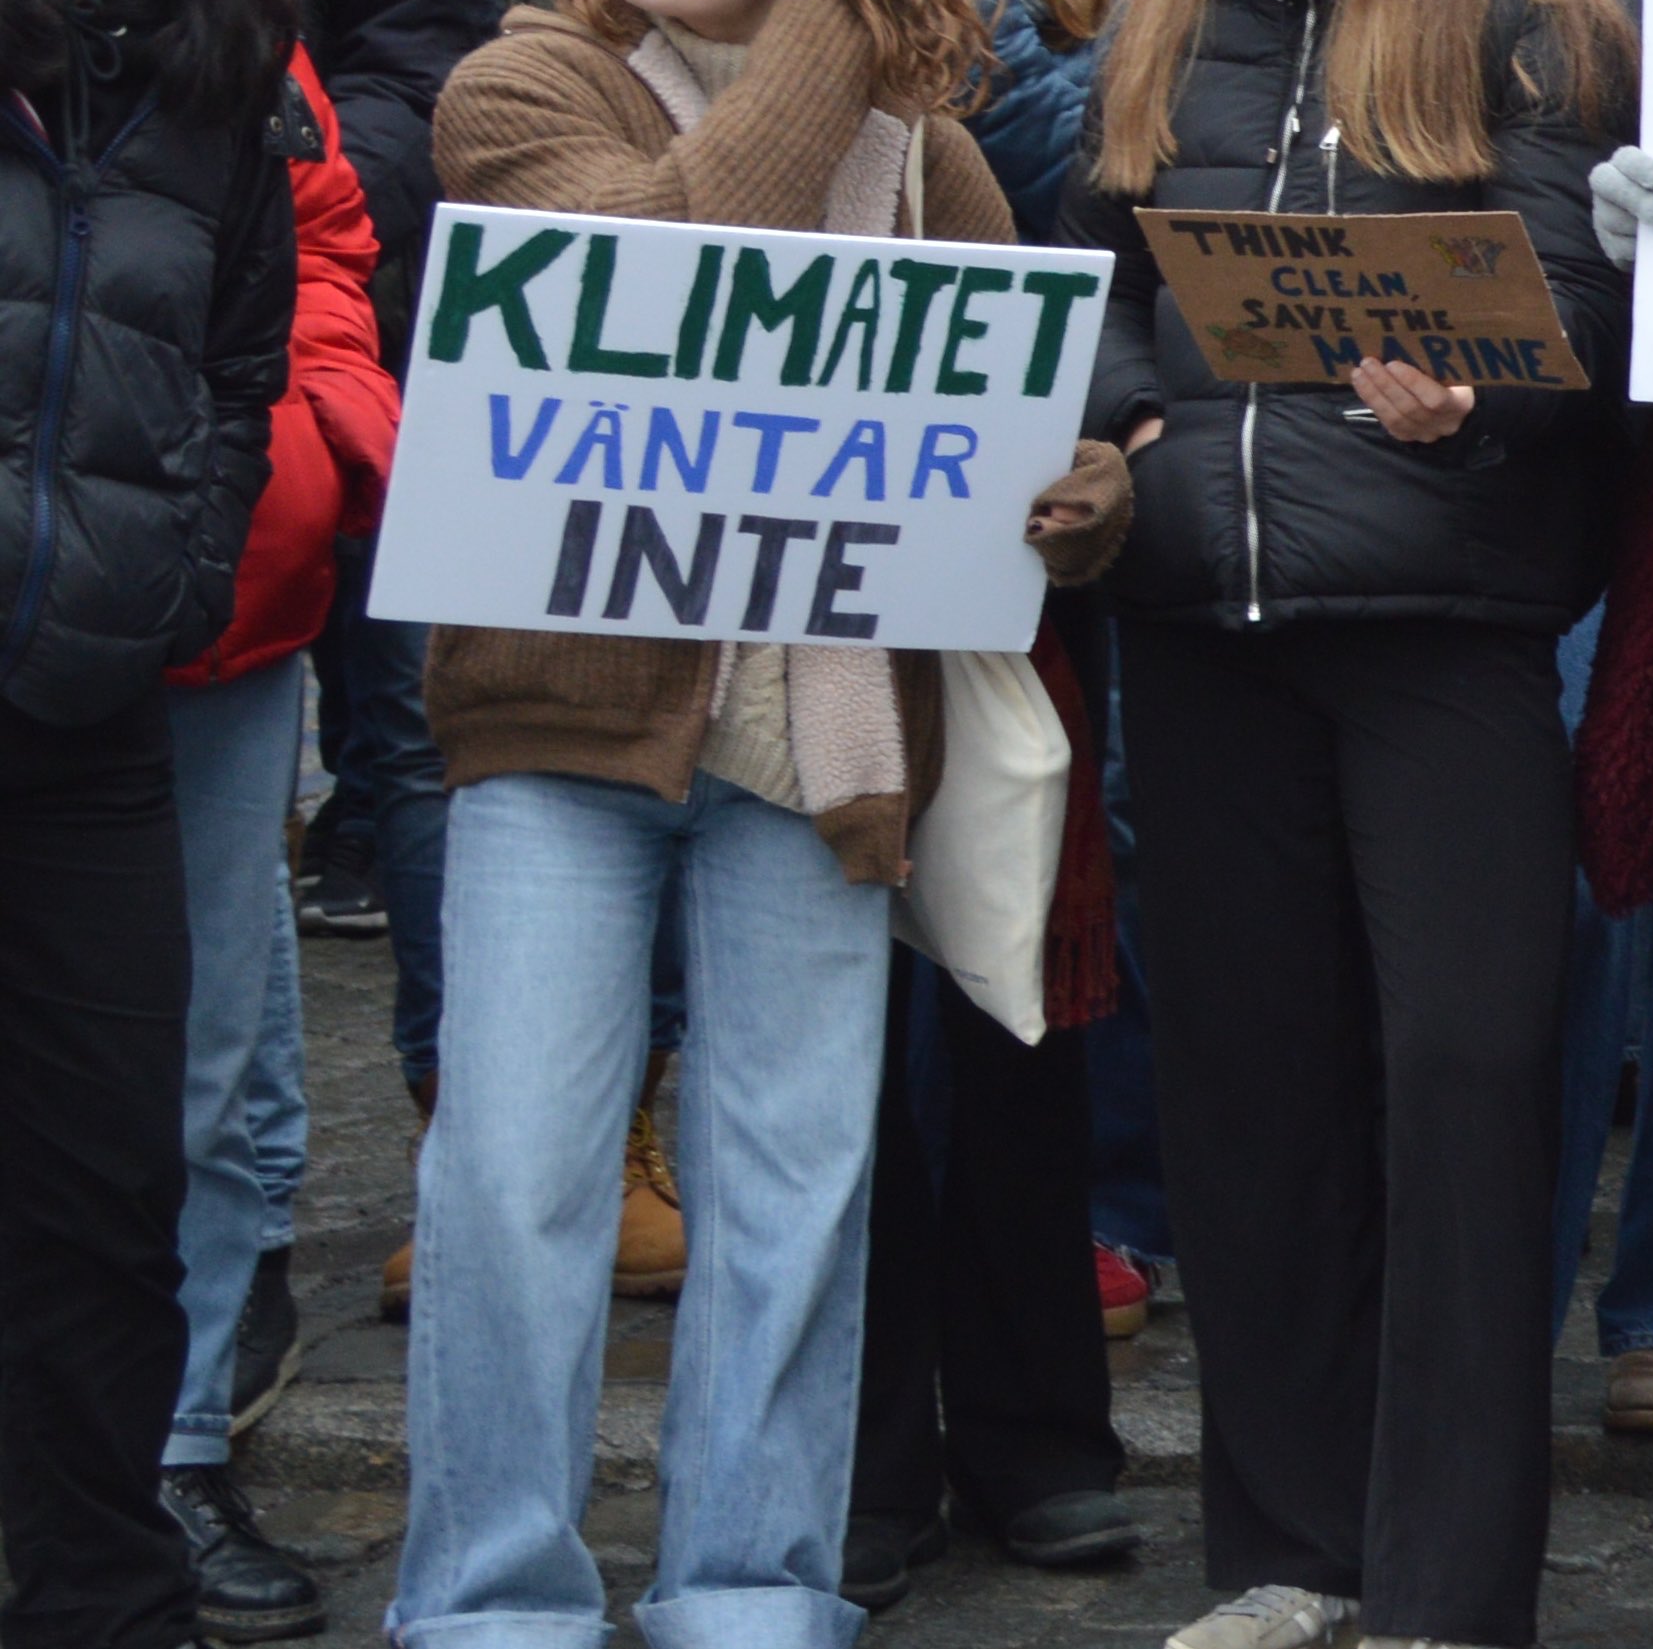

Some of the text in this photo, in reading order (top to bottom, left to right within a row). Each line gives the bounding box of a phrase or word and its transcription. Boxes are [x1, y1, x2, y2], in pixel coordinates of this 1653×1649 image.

[1169, 219, 1355, 259] THINK
[428, 221, 1100, 399] KLIMATET
[1270, 265, 1420, 303] CLEAN,
[1240, 298, 1454, 332] SAVE THE
[1309, 333, 1563, 385] MARINE
[488, 392, 979, 502] VÄNTAR
[546, 499, 902, 641] INTE
